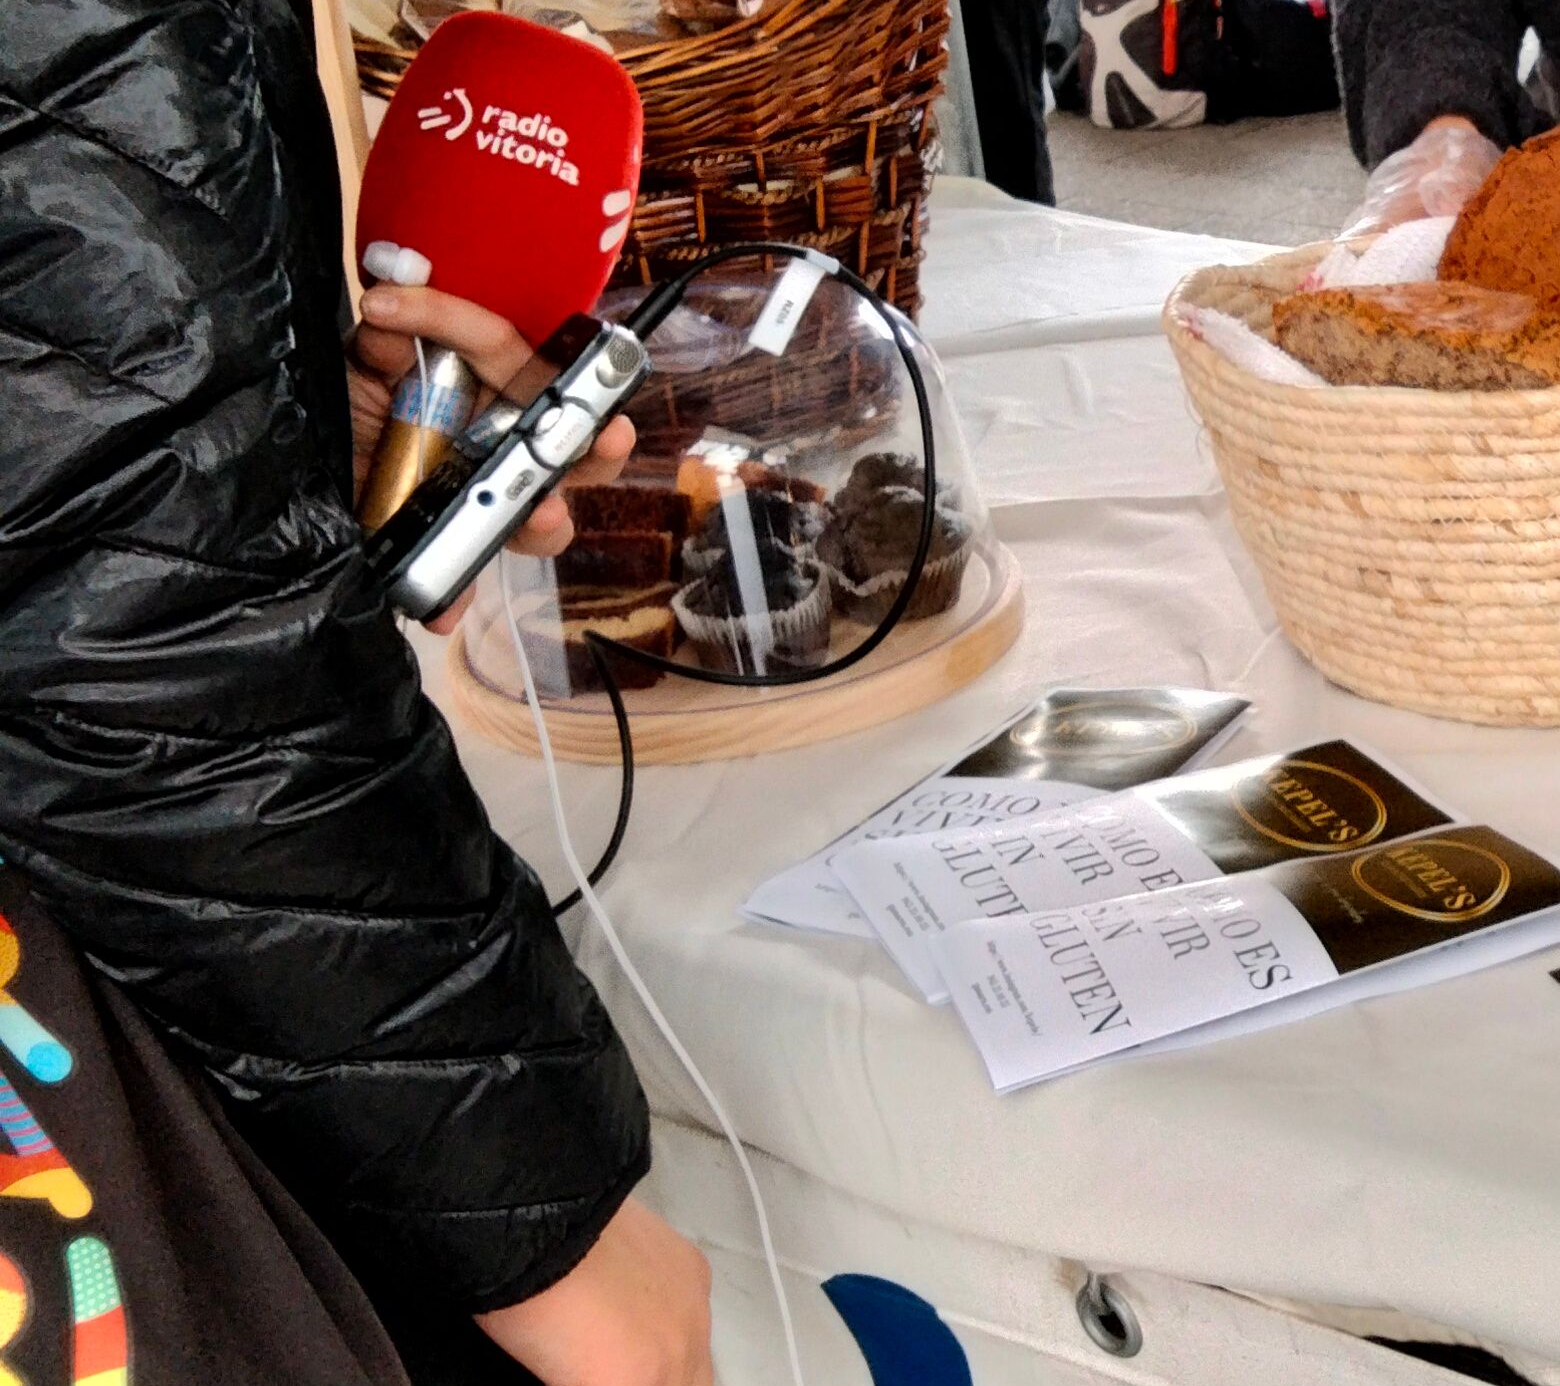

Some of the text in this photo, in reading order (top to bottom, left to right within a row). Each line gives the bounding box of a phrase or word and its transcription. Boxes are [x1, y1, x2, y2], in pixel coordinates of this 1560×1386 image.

[482, 105, 569, 147] radio
[476, 129, 580, 186] vitoria
[1029, 912, 1132, 1036] GLUTEN
[1233, 941, 1293, 990] ES
